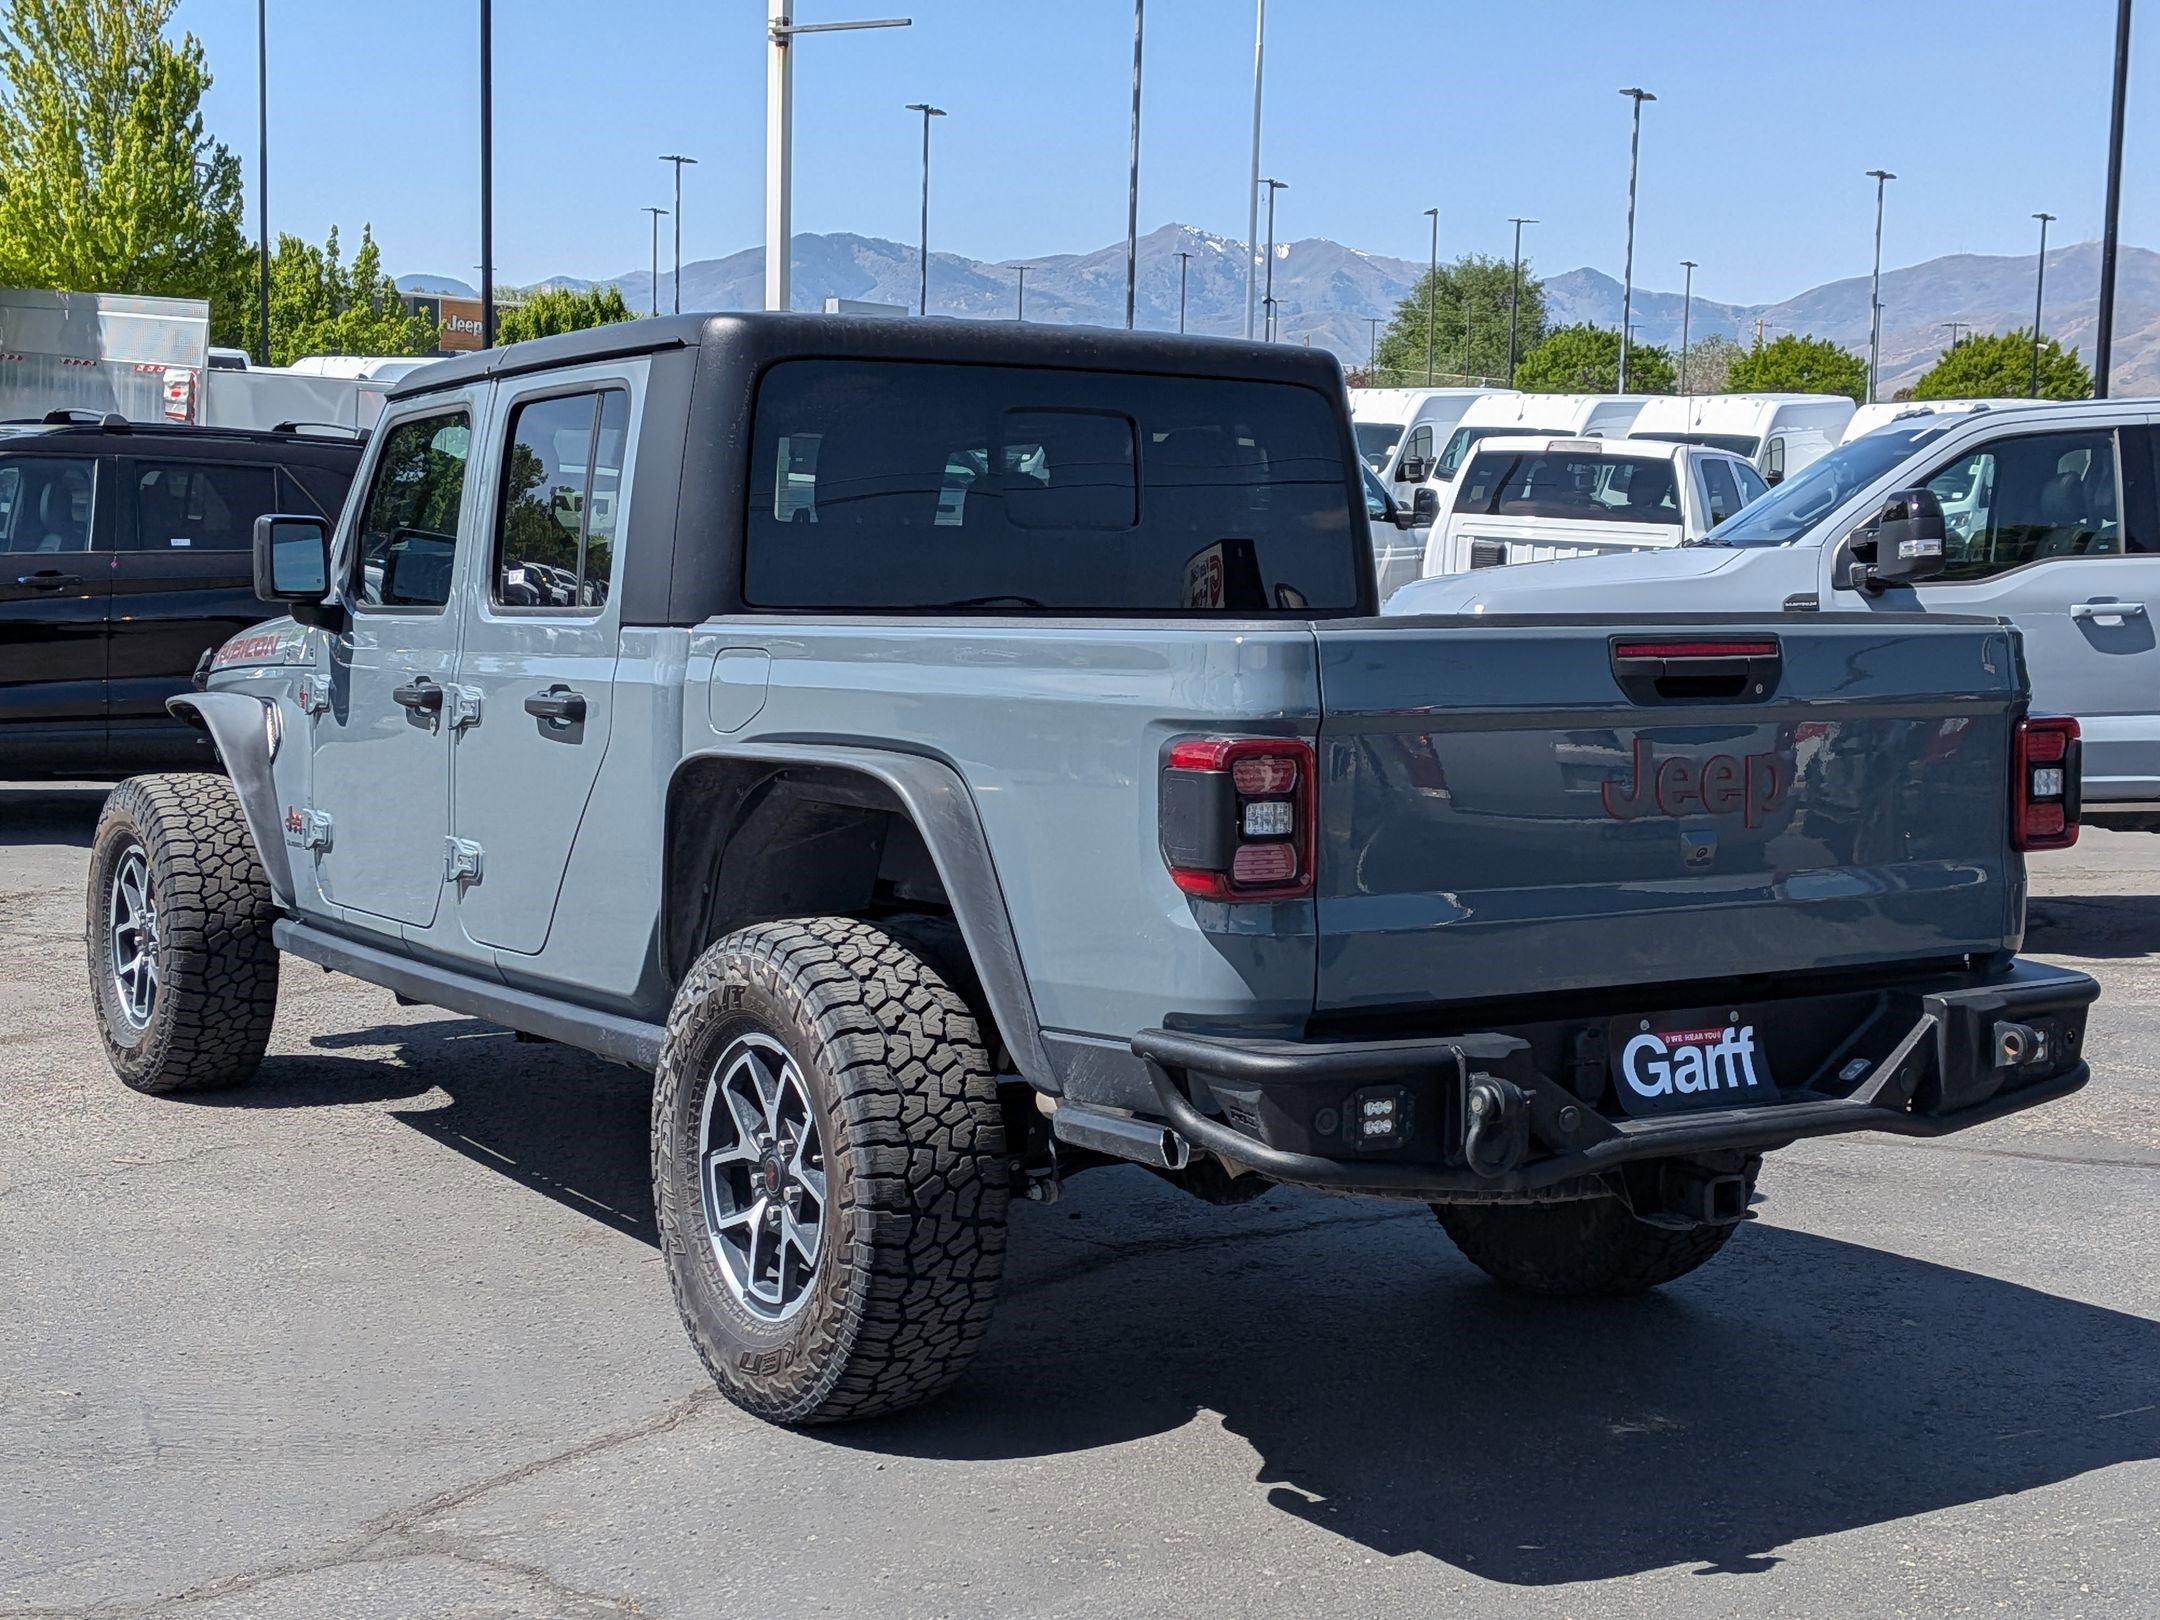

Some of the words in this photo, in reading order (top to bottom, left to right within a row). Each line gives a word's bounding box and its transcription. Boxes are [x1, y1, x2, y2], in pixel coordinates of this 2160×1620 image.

[447, 314, 483, 336] Jeep
[1601, 737, 1786, 829] Jeep
[1622, 1025, 1758, 1097] Garff
[1671, 1034, 1683, 1043] WE
[1684, 1033, 1704, 1041] HEAR
